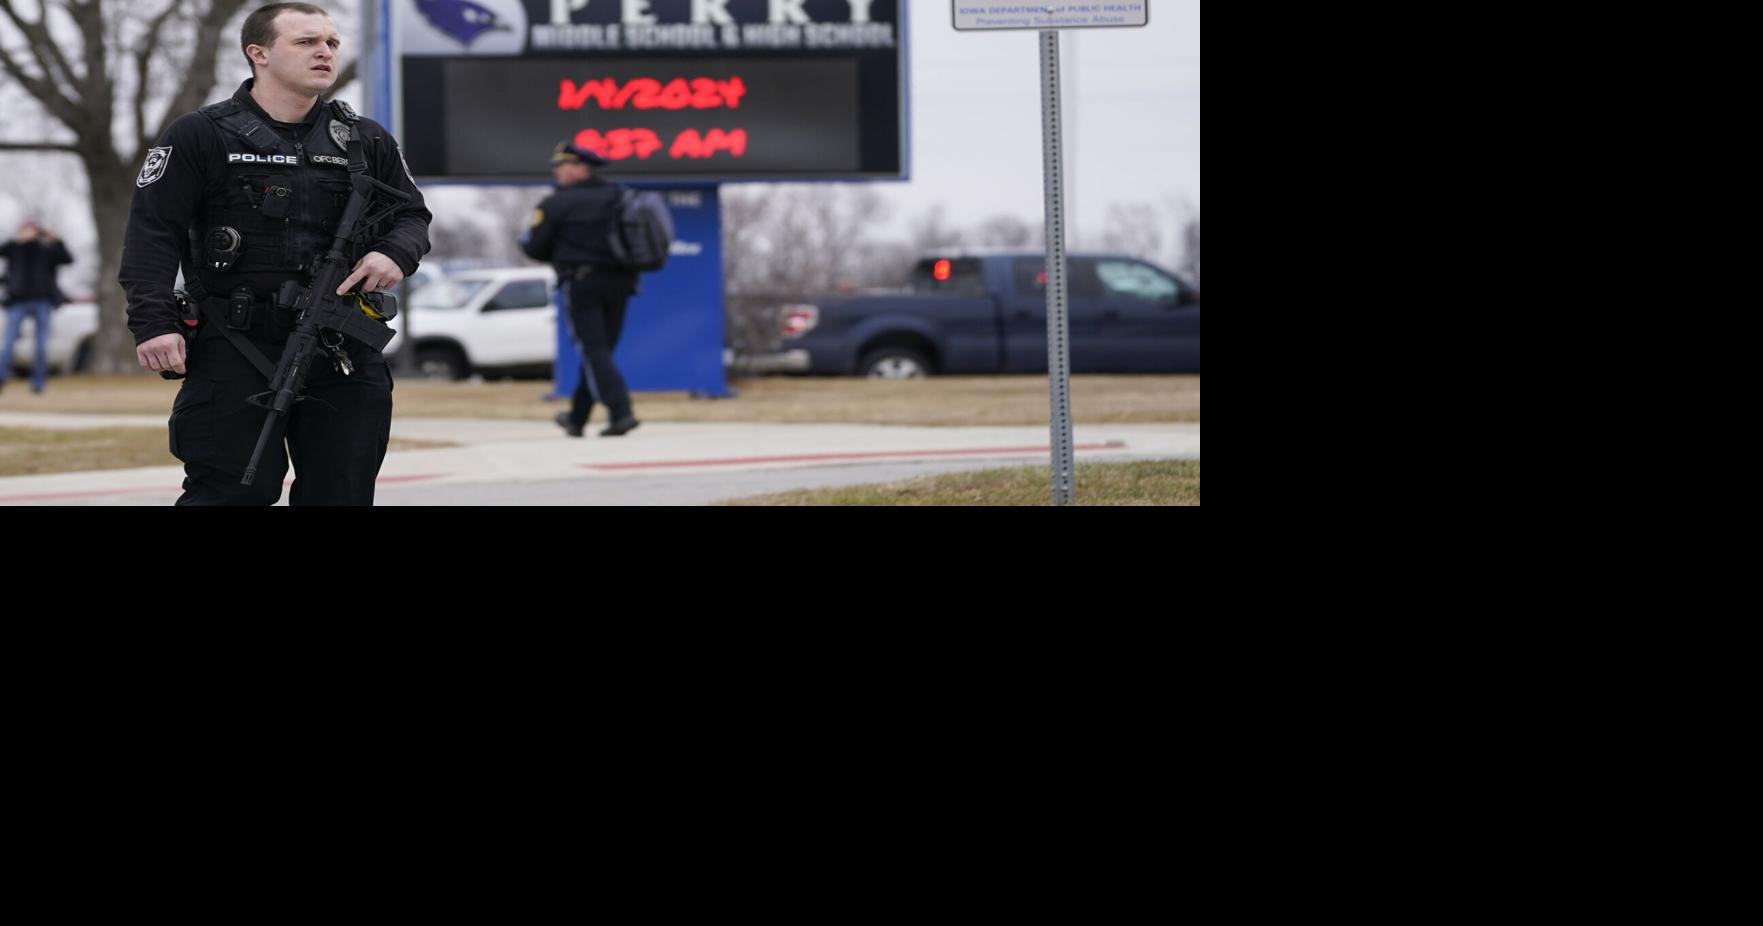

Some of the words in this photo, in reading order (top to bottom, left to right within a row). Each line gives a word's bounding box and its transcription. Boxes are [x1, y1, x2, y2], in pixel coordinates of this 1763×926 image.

[550, 0, 876, 25] PERRY
[960, 7, 986, 15] IOWA
[989, 5, 1054, 14] DEPARTMEN
[1068, 4, 1101, 12] PUBLIC
[976, 17, 1030, 26] Preventing
[1034, 16, 1088, 24] Substance
[532, 24, 619, 47] MIDDLE
[624, 24, 715, 47] SCHOOL
[743, 24, 800, 47] HIGH
[804, 24, 895, 47] SCHOOL
[668, 127, 747, 159] AM
[228, 153, 297, 164] POLICE
